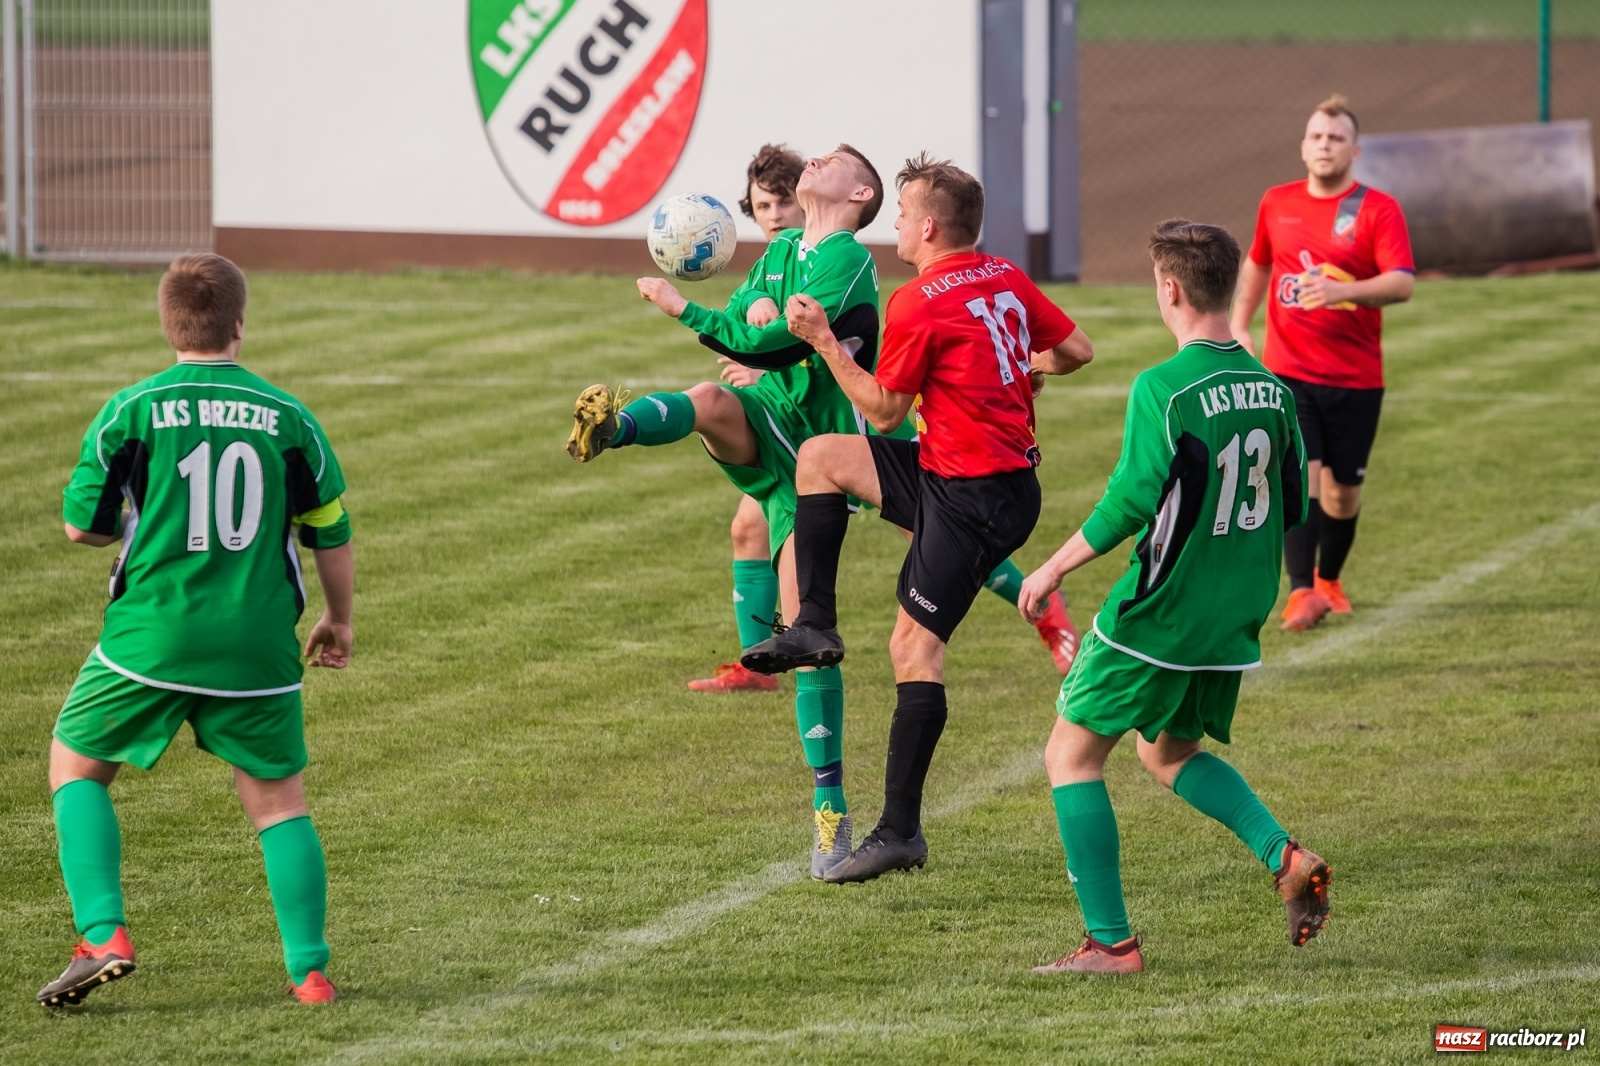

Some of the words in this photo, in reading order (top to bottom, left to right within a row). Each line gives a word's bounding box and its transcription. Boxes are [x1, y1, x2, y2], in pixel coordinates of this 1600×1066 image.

[480, 0, 562, 77] LKS
[520, 0, 649, 152] RUCH
[921, 271, 968, 299] RUCH
[965, 290, 1031, 386] 10
[151, 399, 191, 429] LKS
[198, 399, 280, 436] BRZEZIE
[1199, 385, 1230, 418] LKS
[177, 440, 264, 551] 10
[1213, 428, 1271, 536] 13
